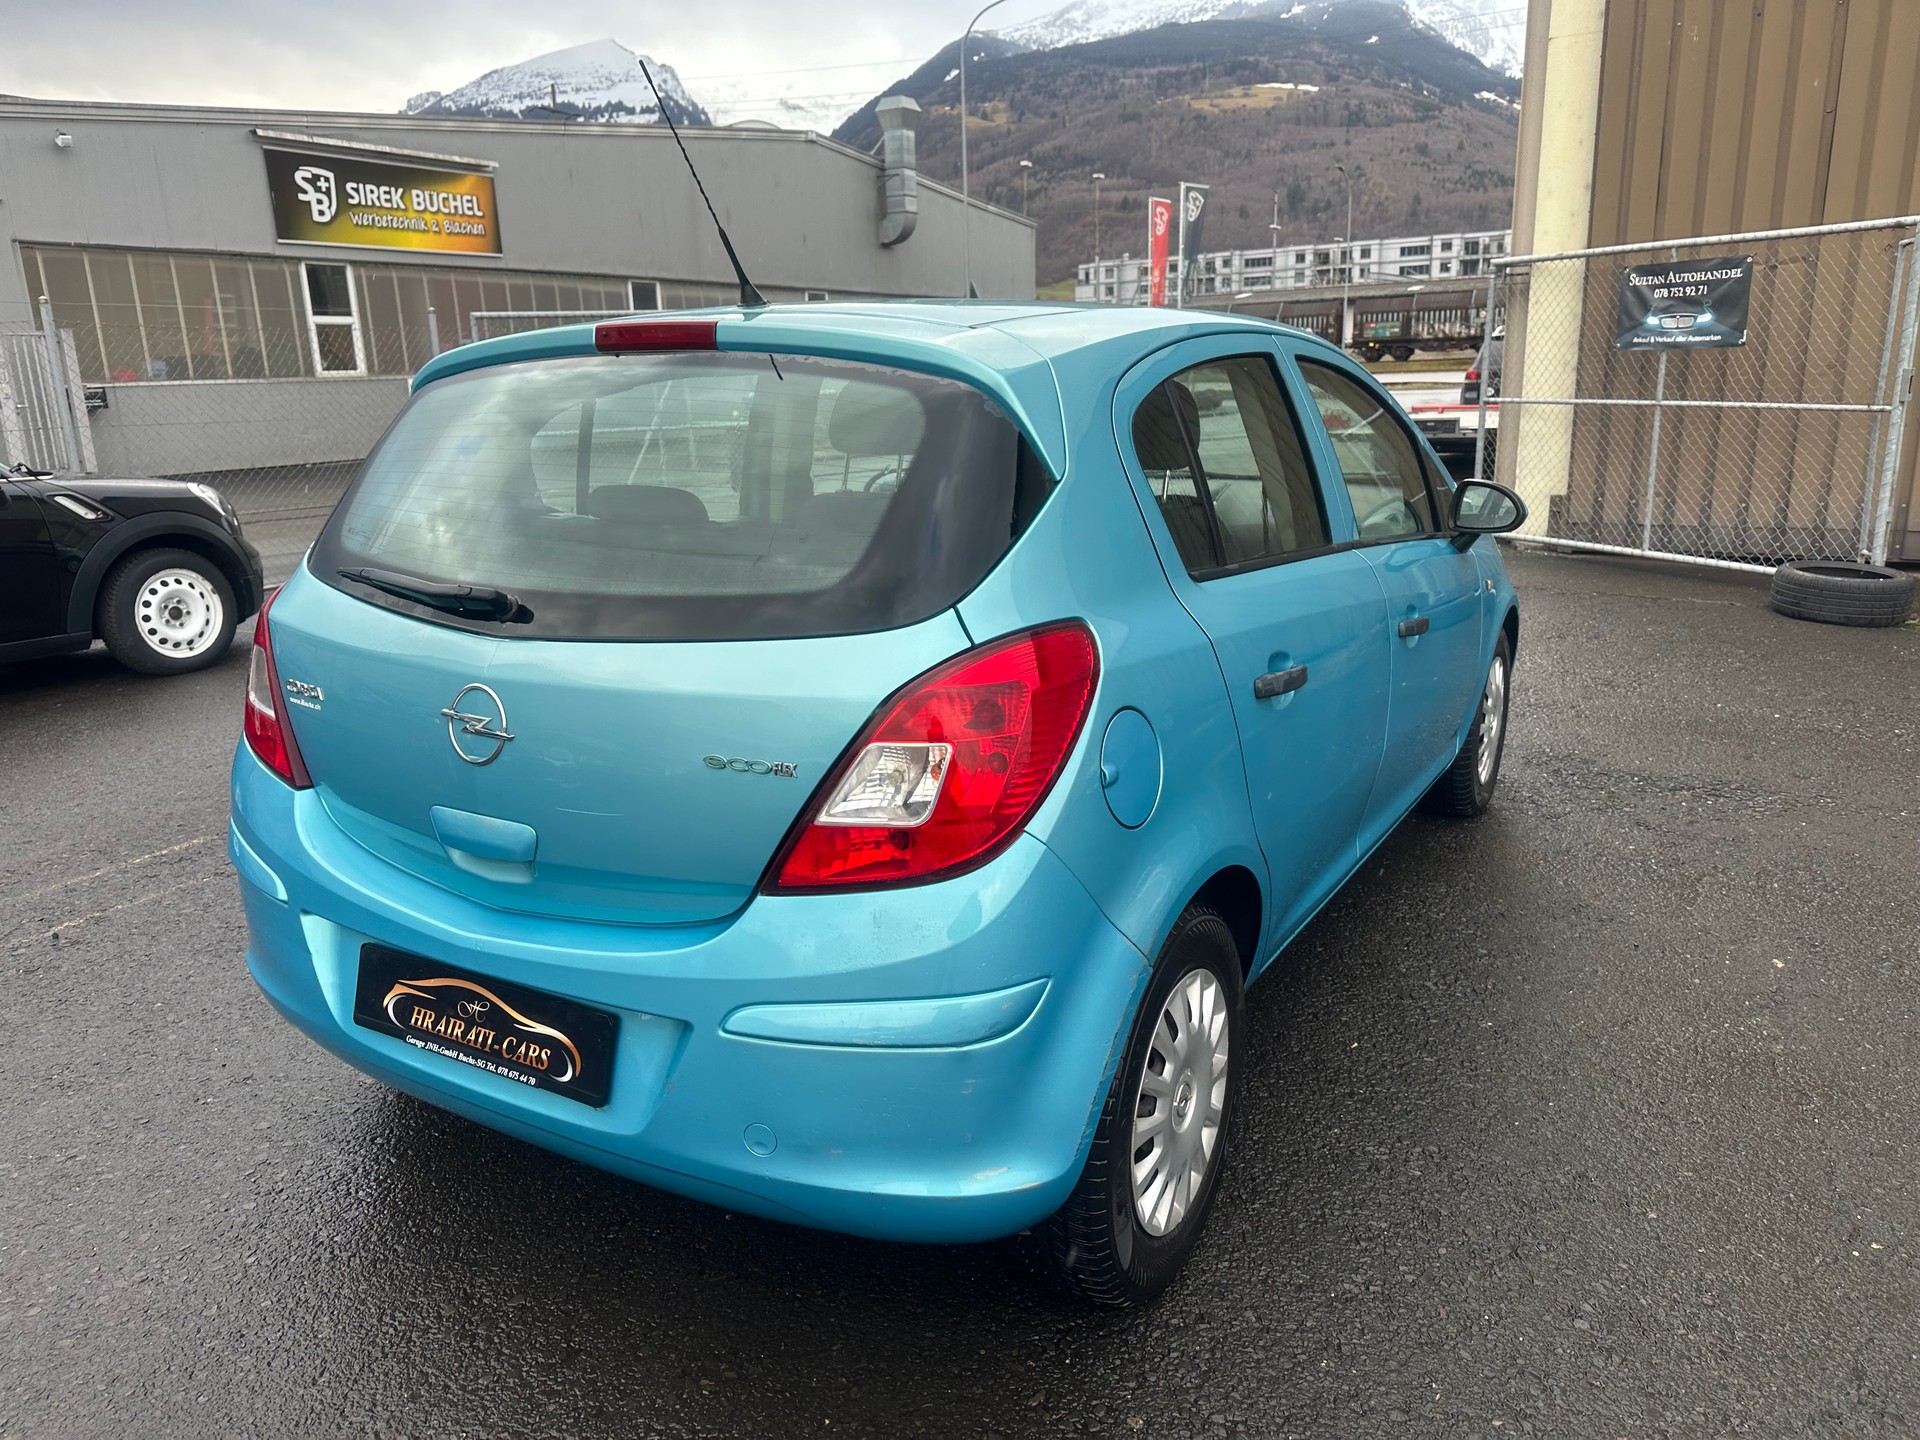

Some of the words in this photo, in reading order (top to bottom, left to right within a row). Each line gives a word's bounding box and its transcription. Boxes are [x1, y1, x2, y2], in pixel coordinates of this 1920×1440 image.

[345, 182, 406, 210] SIREK
[411, 188, 484, 217] BÜCHEL
[349, 211, 428, 231] Werbetechnik
[431, 221, 439, 232] &
[443, 219, 485, 235] Blachen
[1629, 273, 1666, 286] SULTAN
[1666, 268, 1743, 284] AUTOHANDEL
[1654, 289, 1668, 298] 078
[1670, 288, 1683, 297] 752
[1685, 286, 1696, 296] 92
[1698, 285, 1708, 295] 71
[406, 1034, 426, 1049] Garage
[425, 1041, 459, 1060] JNH-GmbH
[458, 1052, 486, 1069] Buchs-SG
[486, 1062, 497, 1073] Tel.
[497, 1066, 508, 1077] 078
[508, 1069, 520, 1080] 675
[519, 1074, 528, 1083] 44
[528, 1076, 536, 1086] 70
